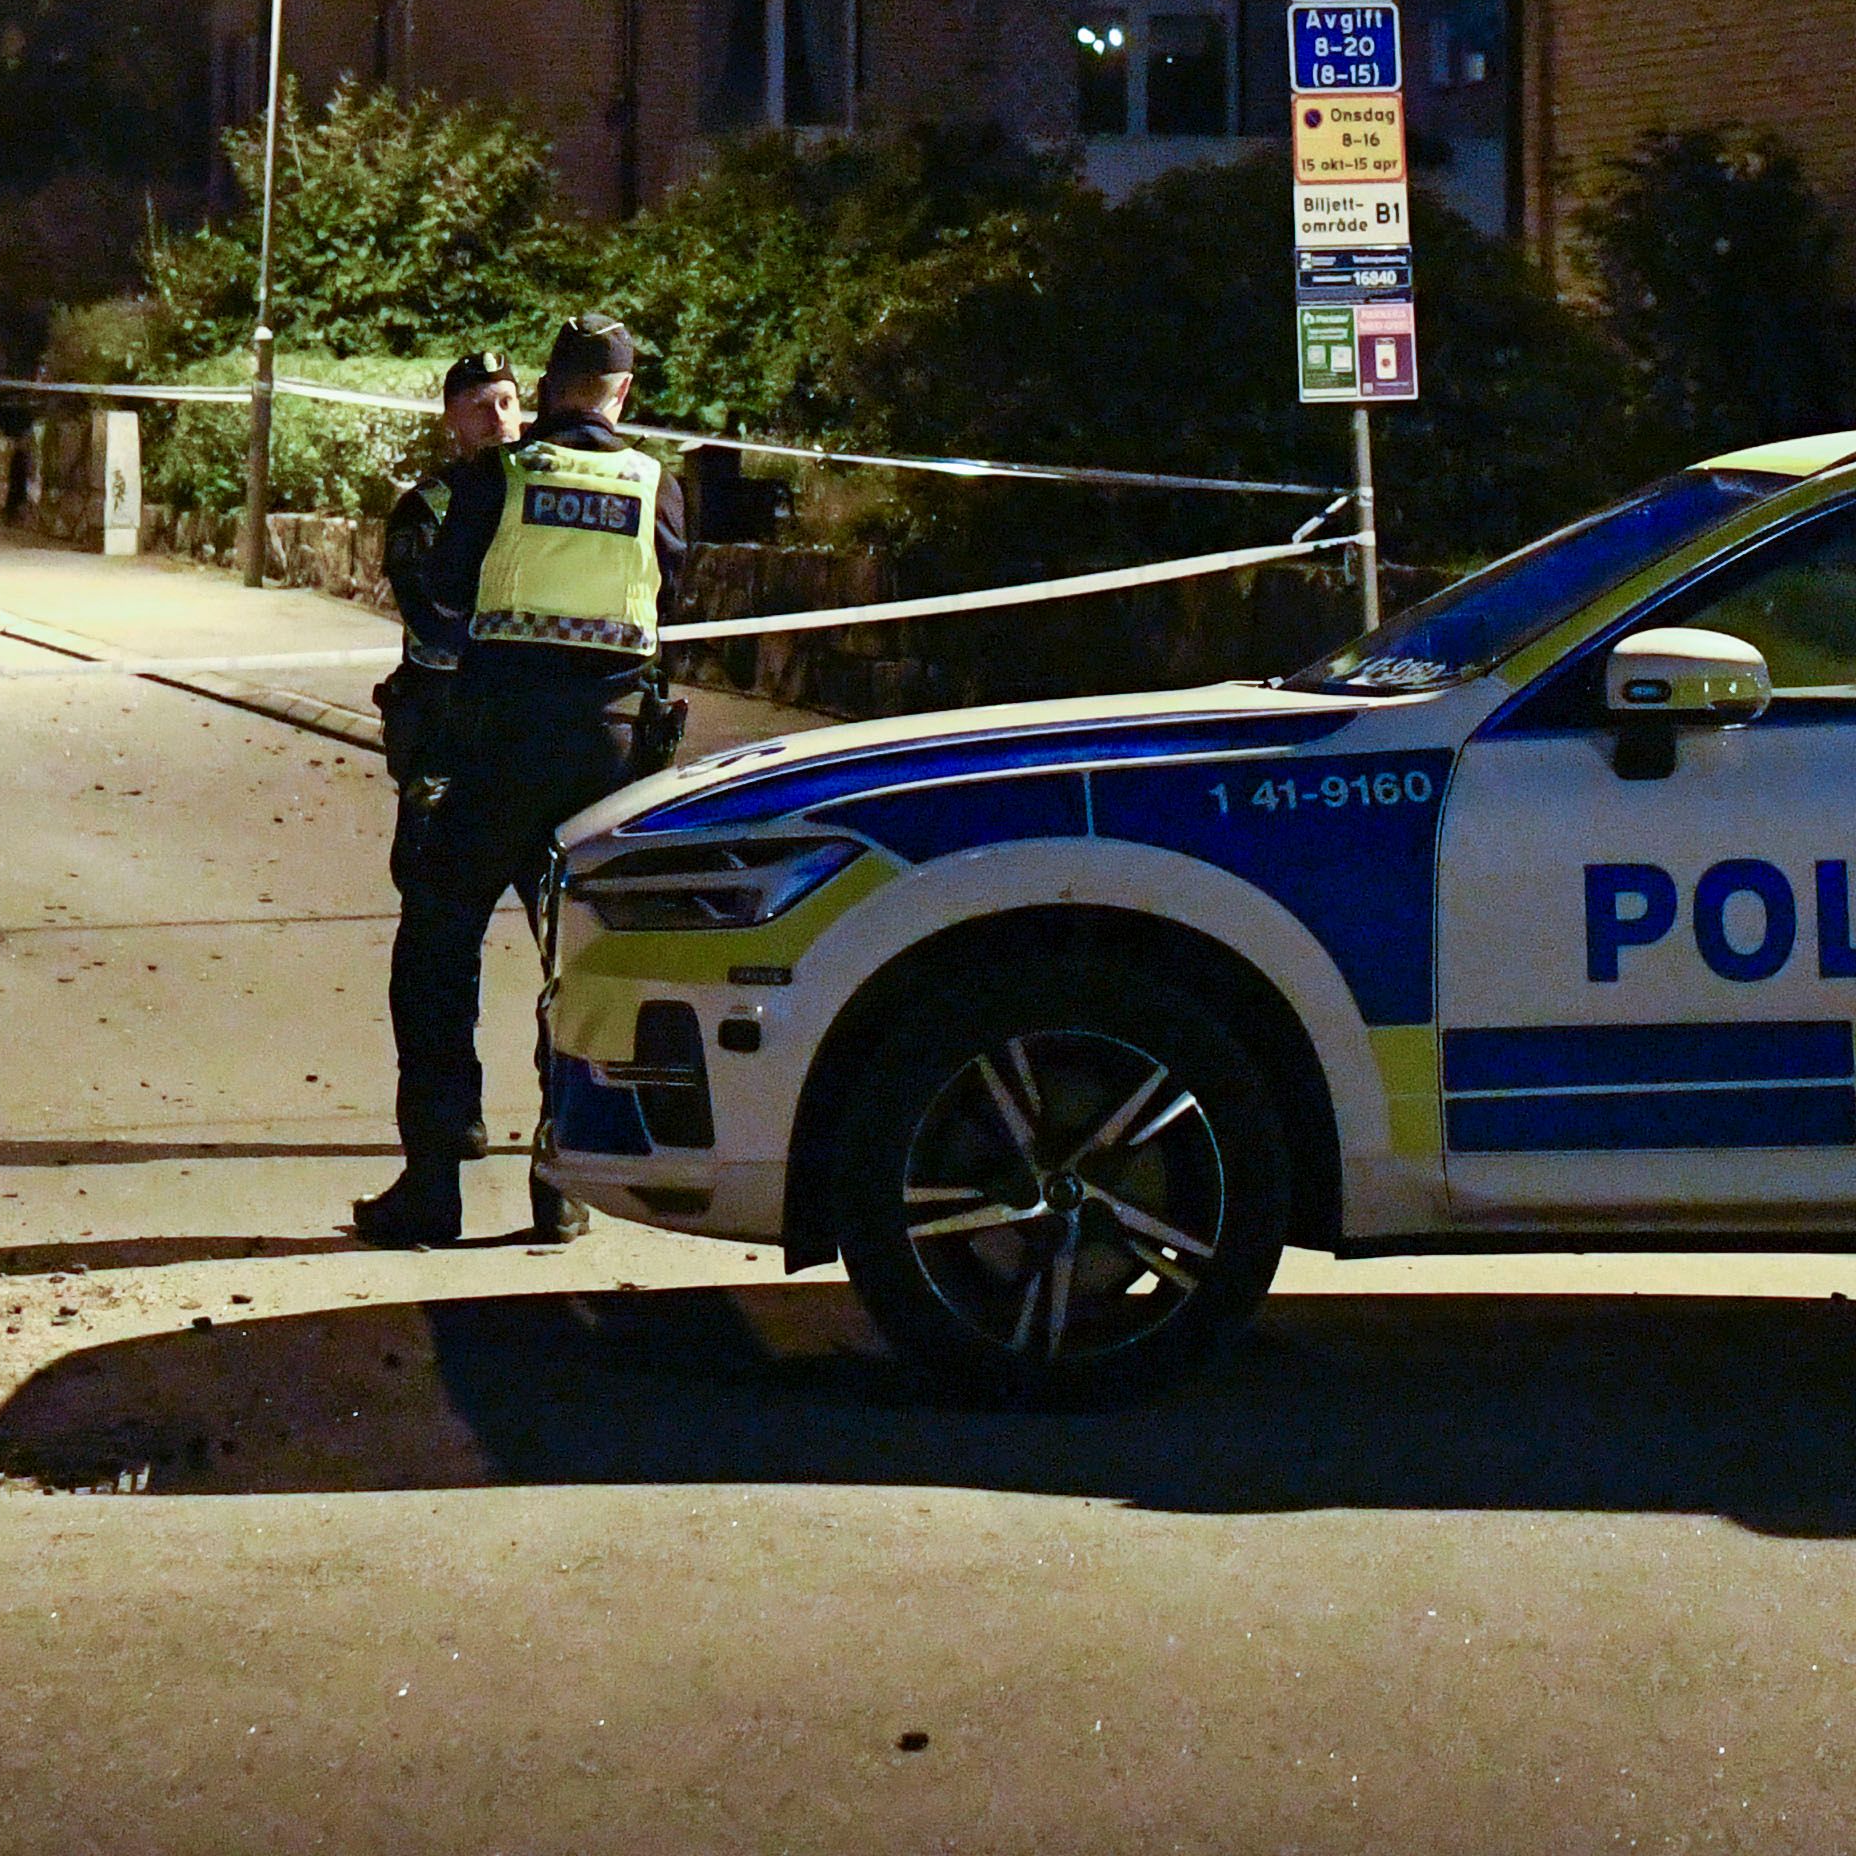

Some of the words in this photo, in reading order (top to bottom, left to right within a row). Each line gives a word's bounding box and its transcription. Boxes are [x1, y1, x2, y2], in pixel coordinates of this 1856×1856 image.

[1305, 8, 1383, 34] Avgift
[1314, 36, 1375, 58] 8-20
[1312, 63, 1380, 87] (8-15)
[1330, 107, 1395, 125] Onsdag
[1341, 132, 1381, 148] 8-16
[1301, 158, 1316, 172] 15
[1372, 158, 1398, 174] apr
[1303, 197, 1364, 216] Biljett-
[1375, 202, 1401, 225] B1
[1301, 216, 1369, 234] område
[533, 490, 629, 529] POLIS
[1209, 782, 1229, 815] 1
[1251, 770, 1433, 811] 41-9160
